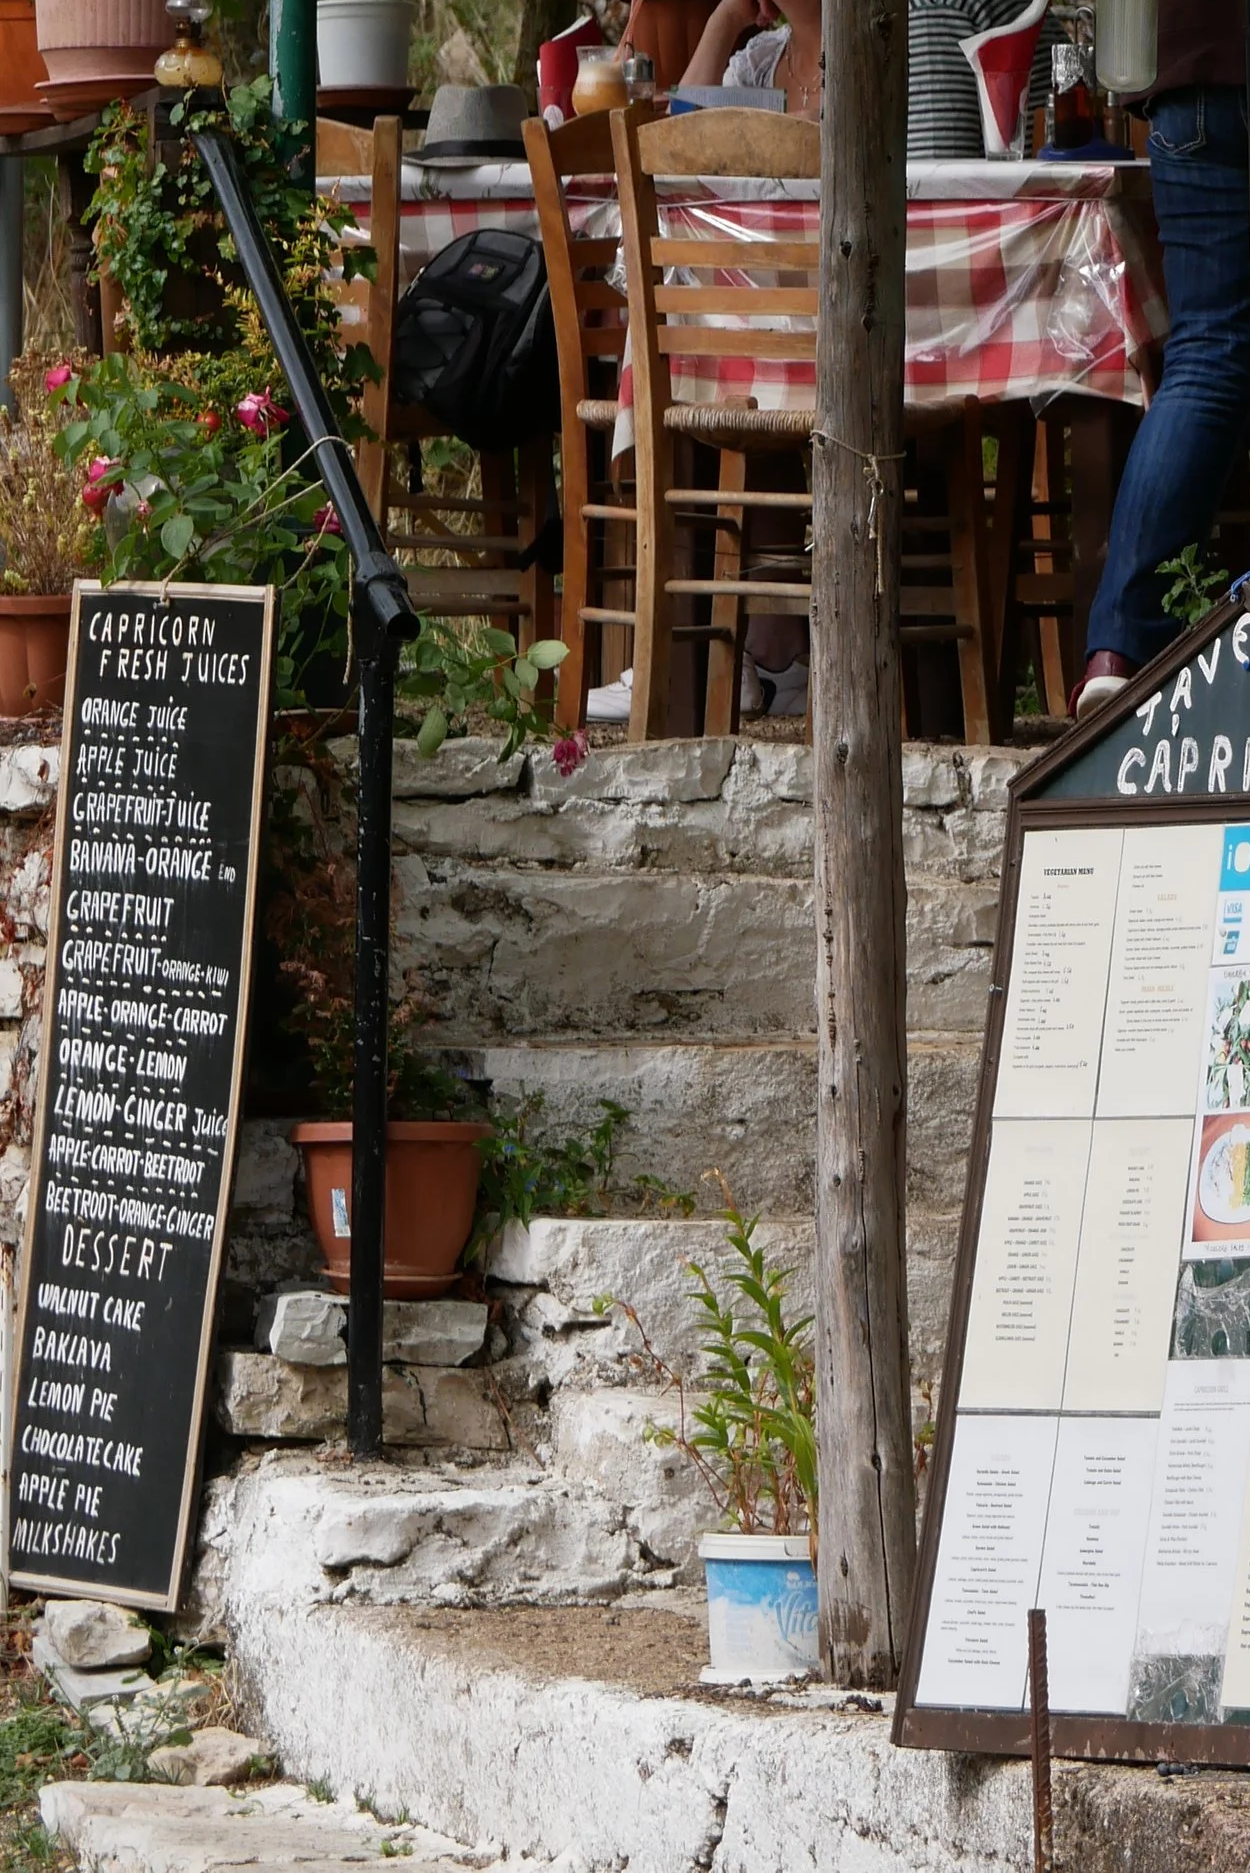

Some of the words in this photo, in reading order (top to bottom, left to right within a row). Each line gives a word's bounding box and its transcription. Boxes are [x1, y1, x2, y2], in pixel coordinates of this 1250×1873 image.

[89, 612, 216, 646] CAPRICORN
[100, 648, 168, 680] FRESH
[181, 652, 250, 685] JUICES
[82, 697, 140, 727] ORANGE
[76, 743, 126, 775] APPLE
[1043, 868, 1077, 876] VEGETARIAN
[67, 890, 174, 927] GRAPEFRUIT
[1227, 902, 1242, 914] VISA
[62, 1224, 173, 1282] DESSERT
[38, 1283, 99, 1320] WALNUT
[103, 1295, 145, 1332] CAKE
[33, 1326, 111, 1372] BAKLAVA
[28, 1377, 86, 1414] LEMON
[90, 1387, 118, 1422] PIE
[22, 1424, 103, 1467] CHOCOLATE
[103, 1439, 144, 1477] CAKE
[19, 1472, 70, 1510] APPLE
[74, 1484, 103, 1518] PIE
[12, 1517, 121, 1565] MILKSHAKES
